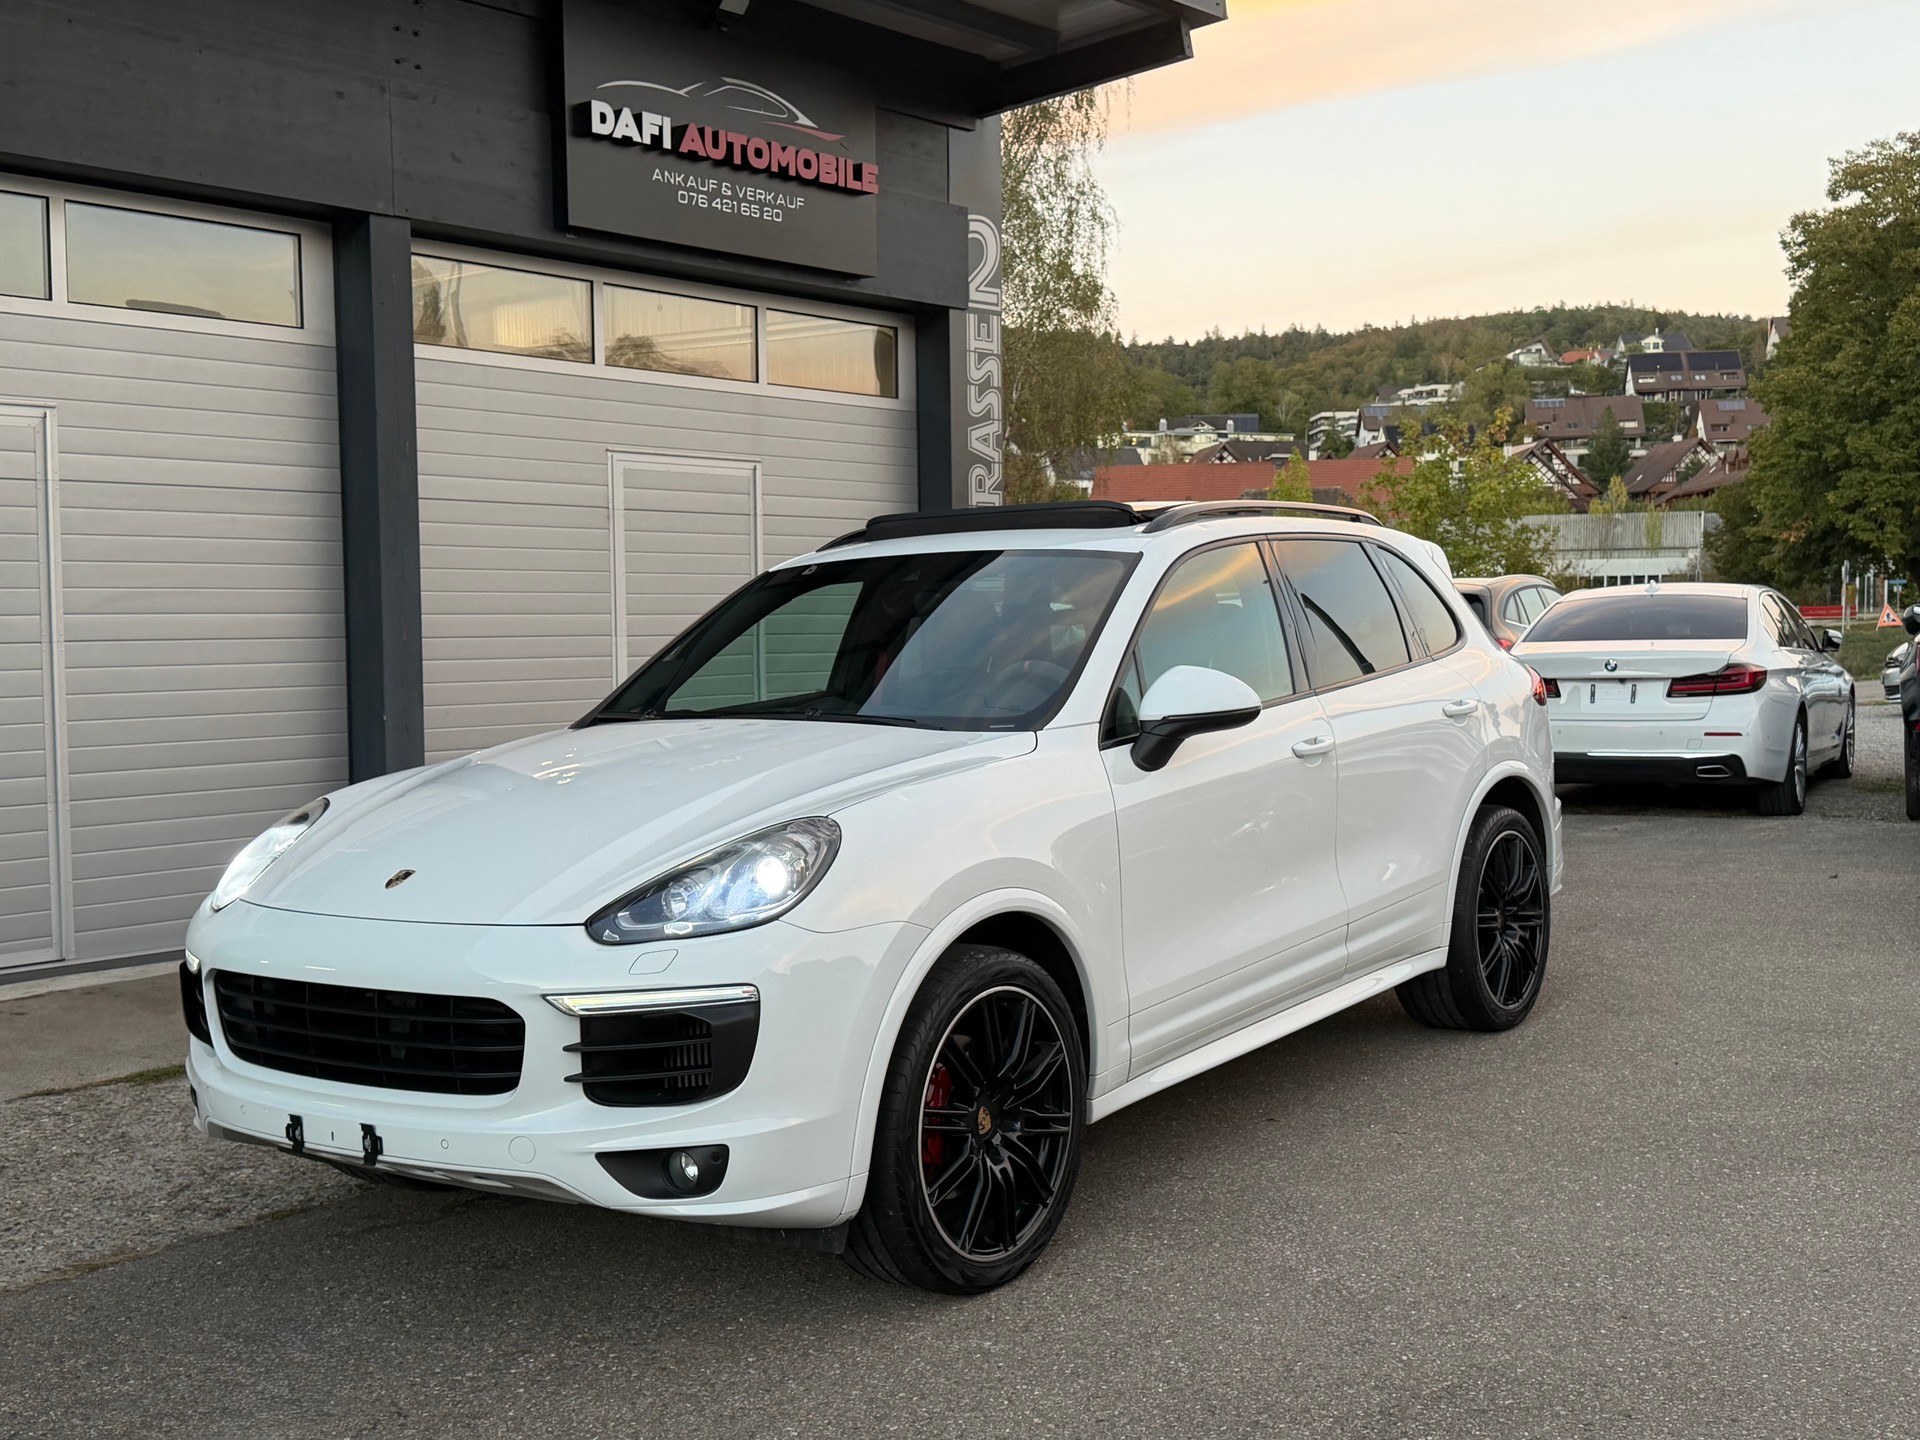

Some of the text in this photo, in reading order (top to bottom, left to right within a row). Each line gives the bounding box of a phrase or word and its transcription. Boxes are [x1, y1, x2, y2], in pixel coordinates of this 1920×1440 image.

[591, 99, 879, 194] DAFI AUTOMOBILE
[652, 168, 805, 209] ANKAUF & VERKAUF
[677, 190, 783, 222] 076 421 65 20
[966, 312, 1002, 508] RASSE
